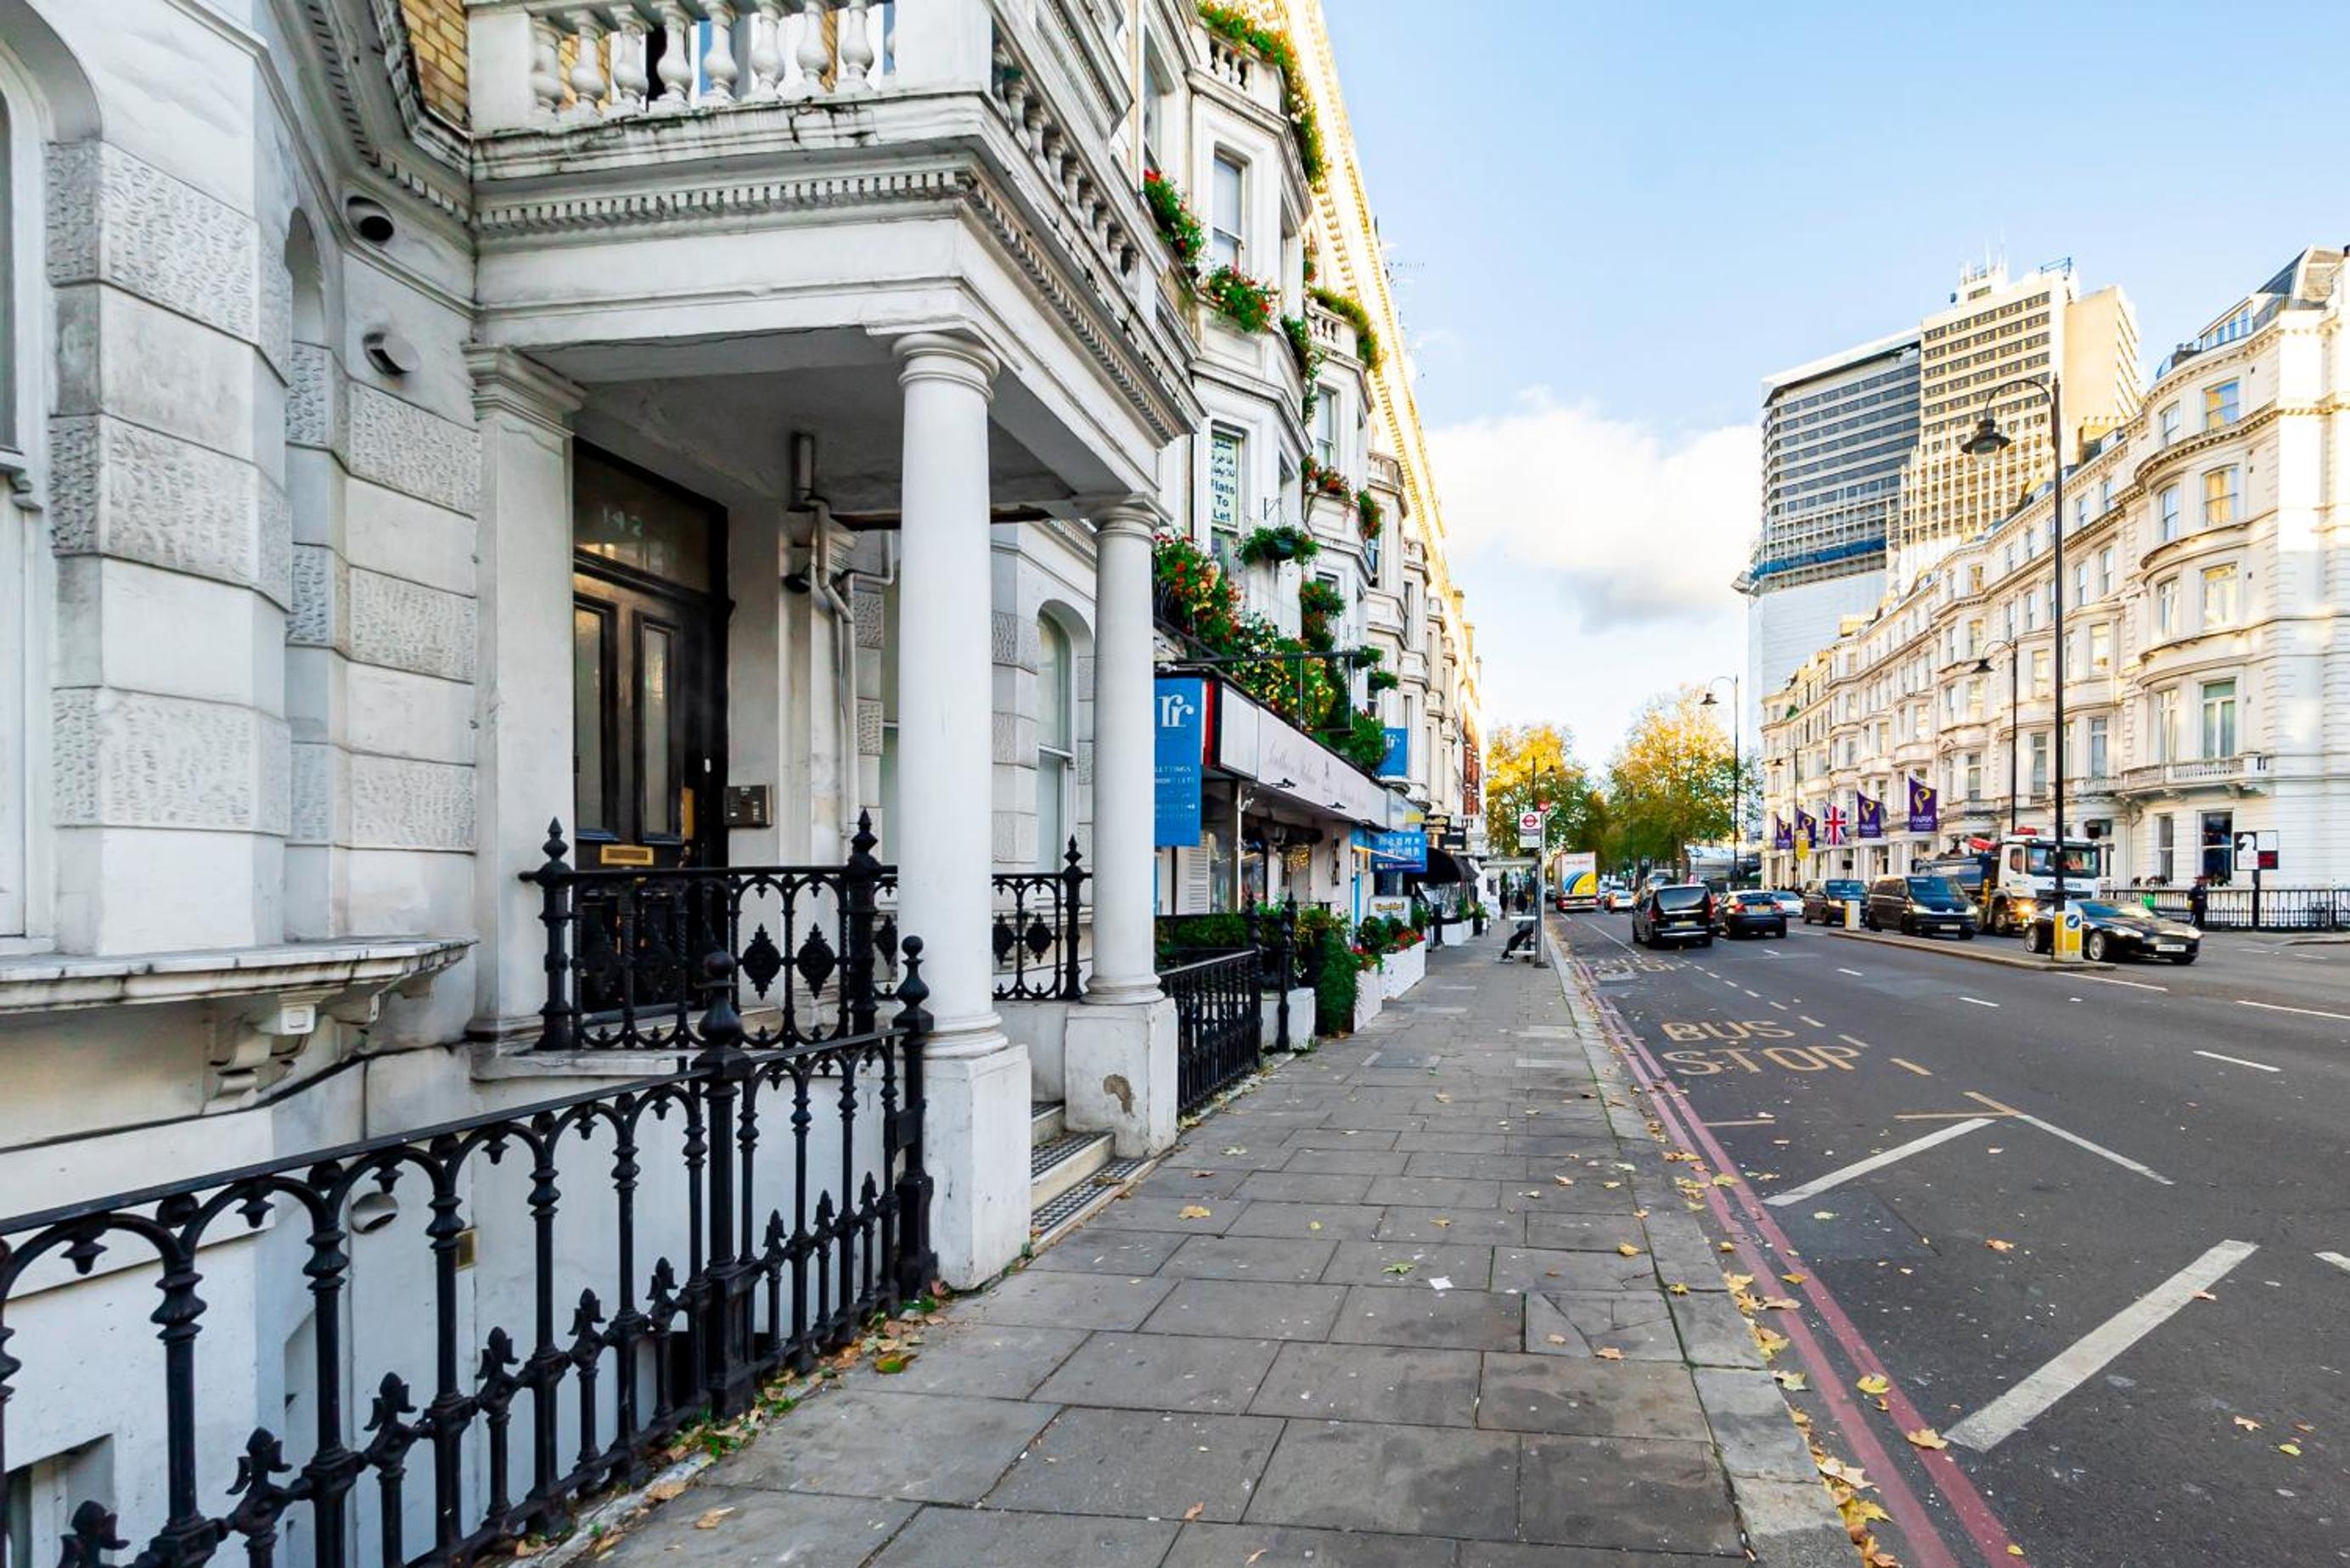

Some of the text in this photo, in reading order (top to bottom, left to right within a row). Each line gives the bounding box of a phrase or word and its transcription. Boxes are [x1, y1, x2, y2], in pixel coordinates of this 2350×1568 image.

[1215, 494, 1229, 508] To
[1212, 508, 1231, 522] Let
[1661, 1020, 1796, 1042] BUS
[1661, 1045, 1861, 1076] STOP
